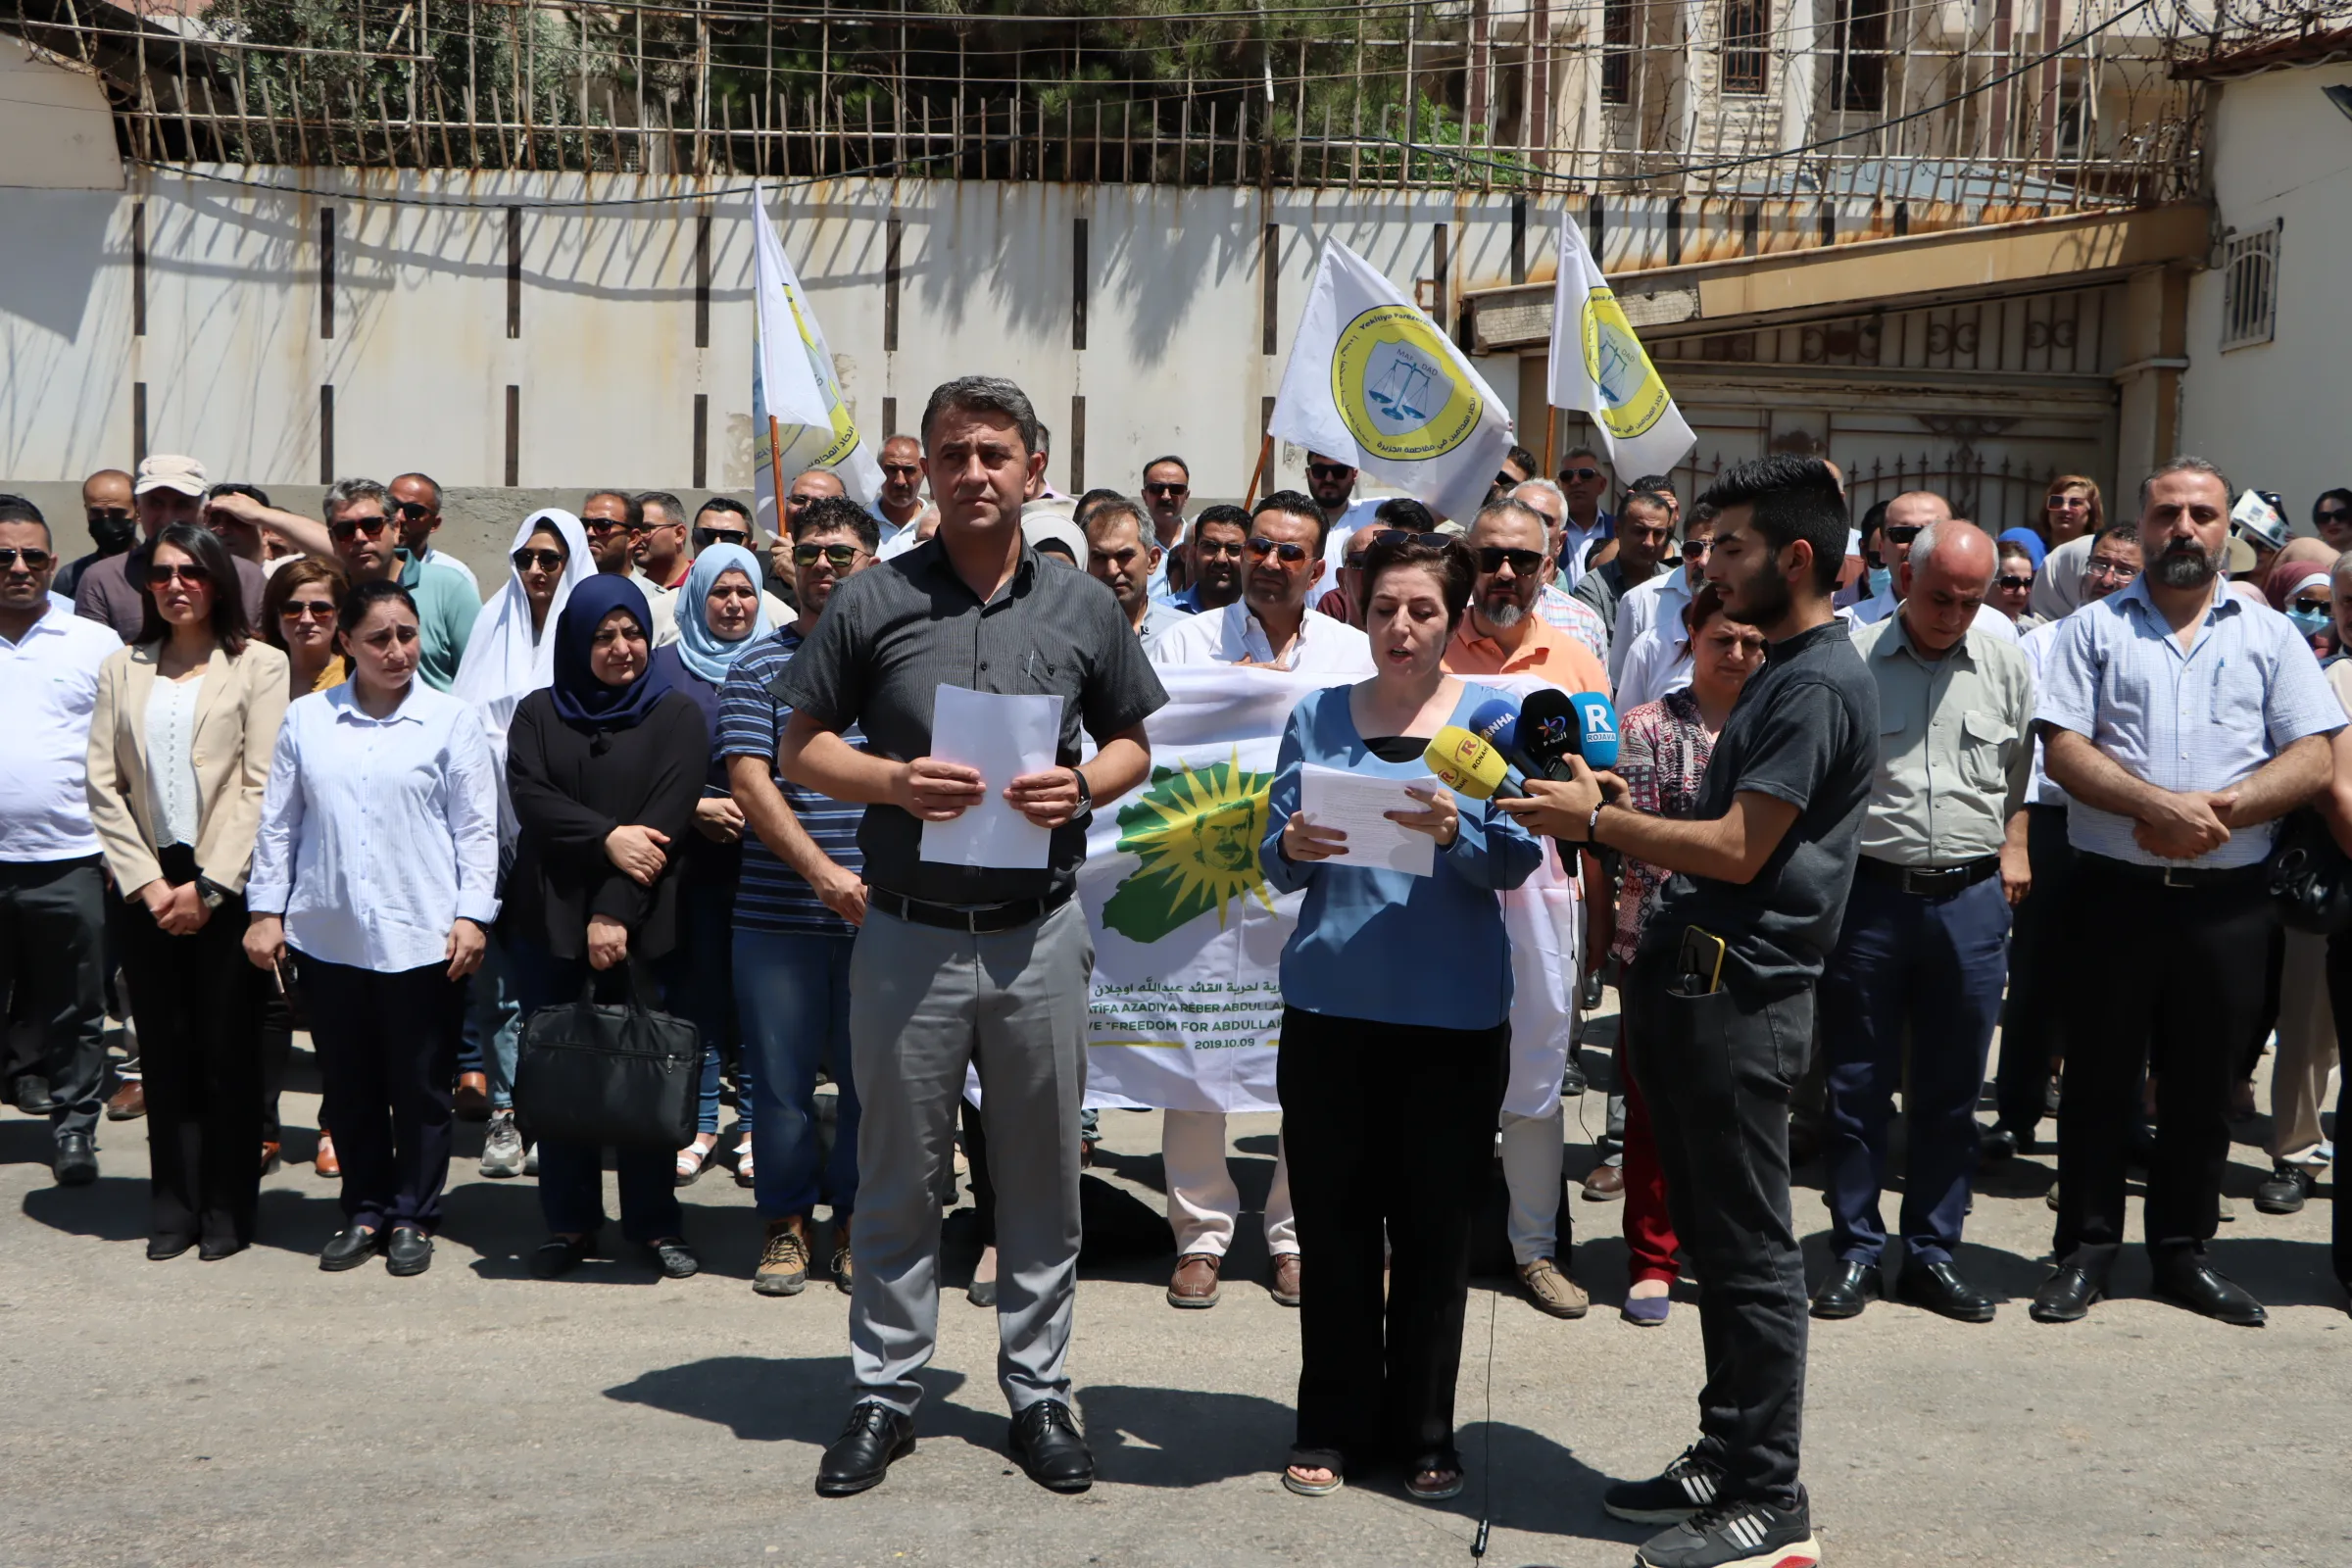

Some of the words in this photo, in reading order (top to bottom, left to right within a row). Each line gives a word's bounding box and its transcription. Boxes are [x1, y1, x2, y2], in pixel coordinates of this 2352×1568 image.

[1396, 348, 1414, 361] MAF
[1421, 363, 1439, 376] DAD
[1585, 705, 1612, 732] R
[1483, 712, 1516, 741] ANHA
[1181, 1021, 1208, 1033] FOR
[1195, 1038, 1255, 1050] 2019.10.09
